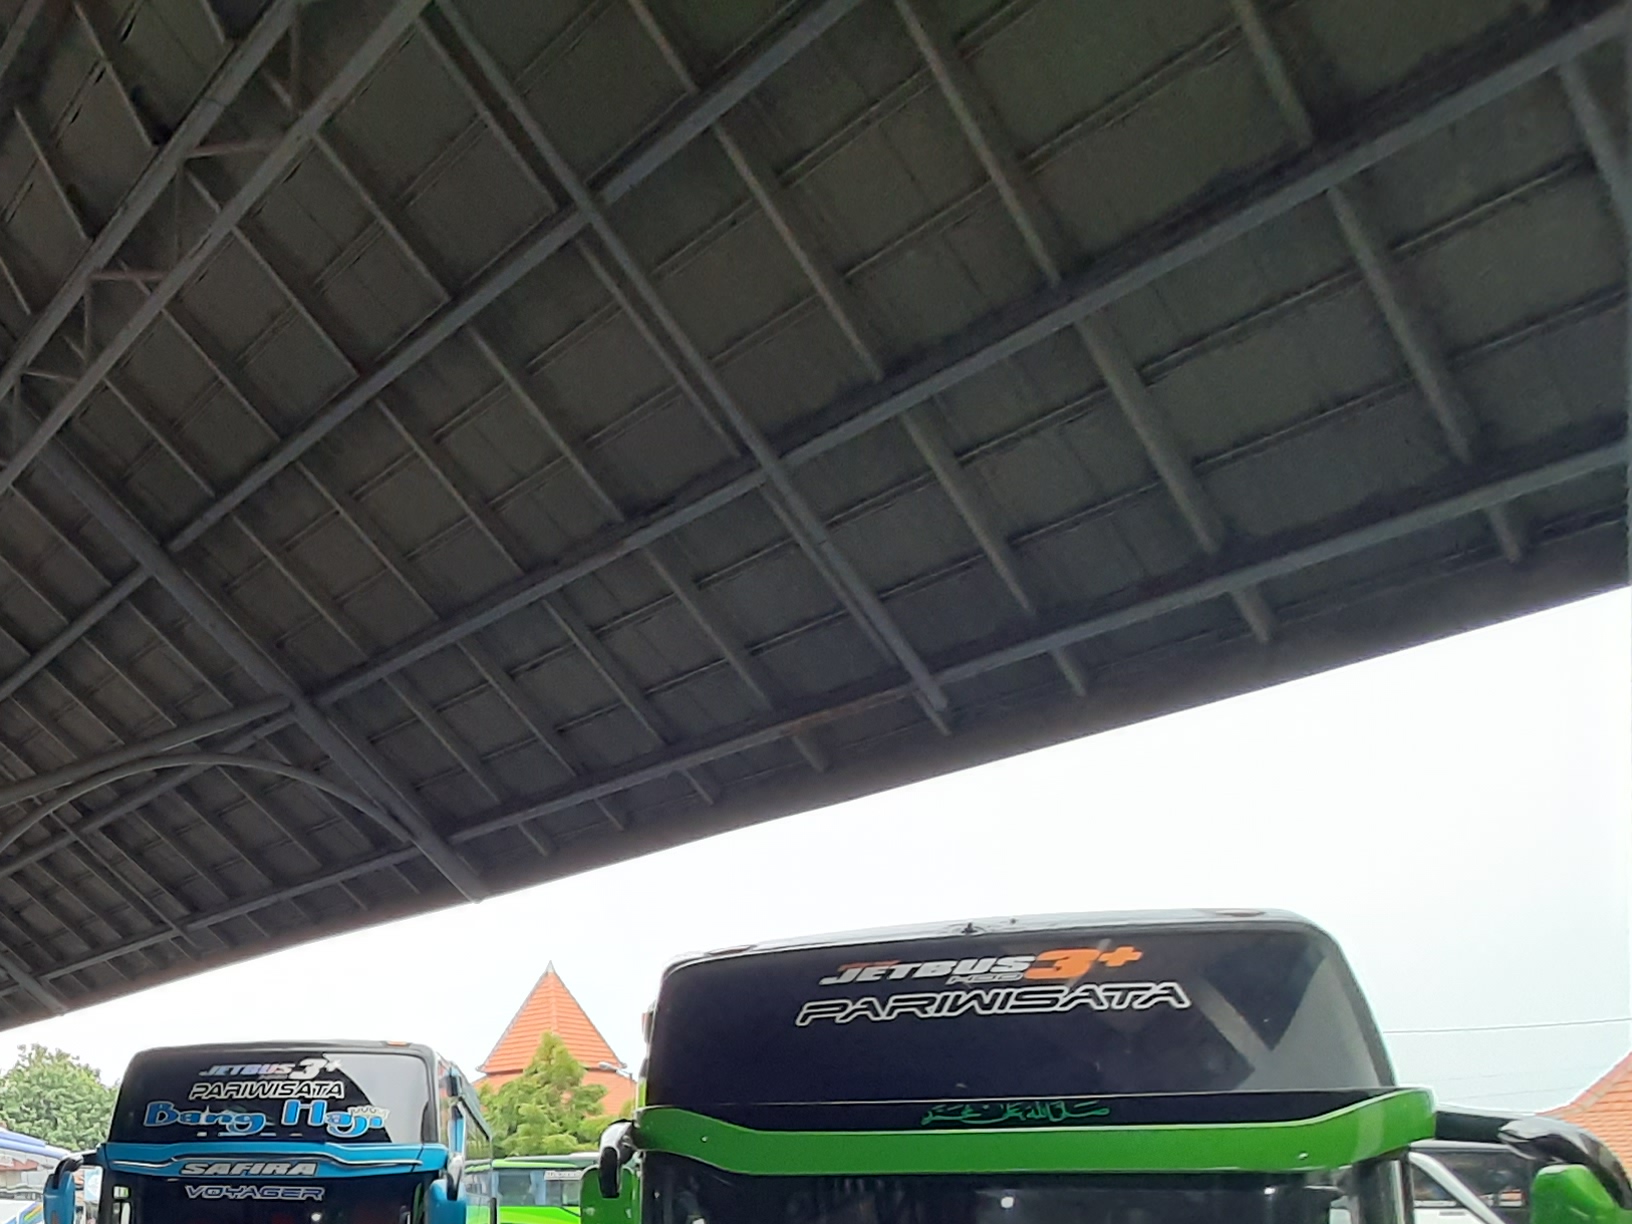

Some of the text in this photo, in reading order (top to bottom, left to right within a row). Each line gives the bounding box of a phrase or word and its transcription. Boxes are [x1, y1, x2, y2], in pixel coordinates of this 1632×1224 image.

[795, 981, 1191, 1026] PARIWISATA
[189, 1081, 345, 1099] PARIWISATA
[143, 1101, 266, 1135] Bang
[181, 1162, 317, 1176] SAFIRA
[185, 1185, 325, 1201] VOYAGER
